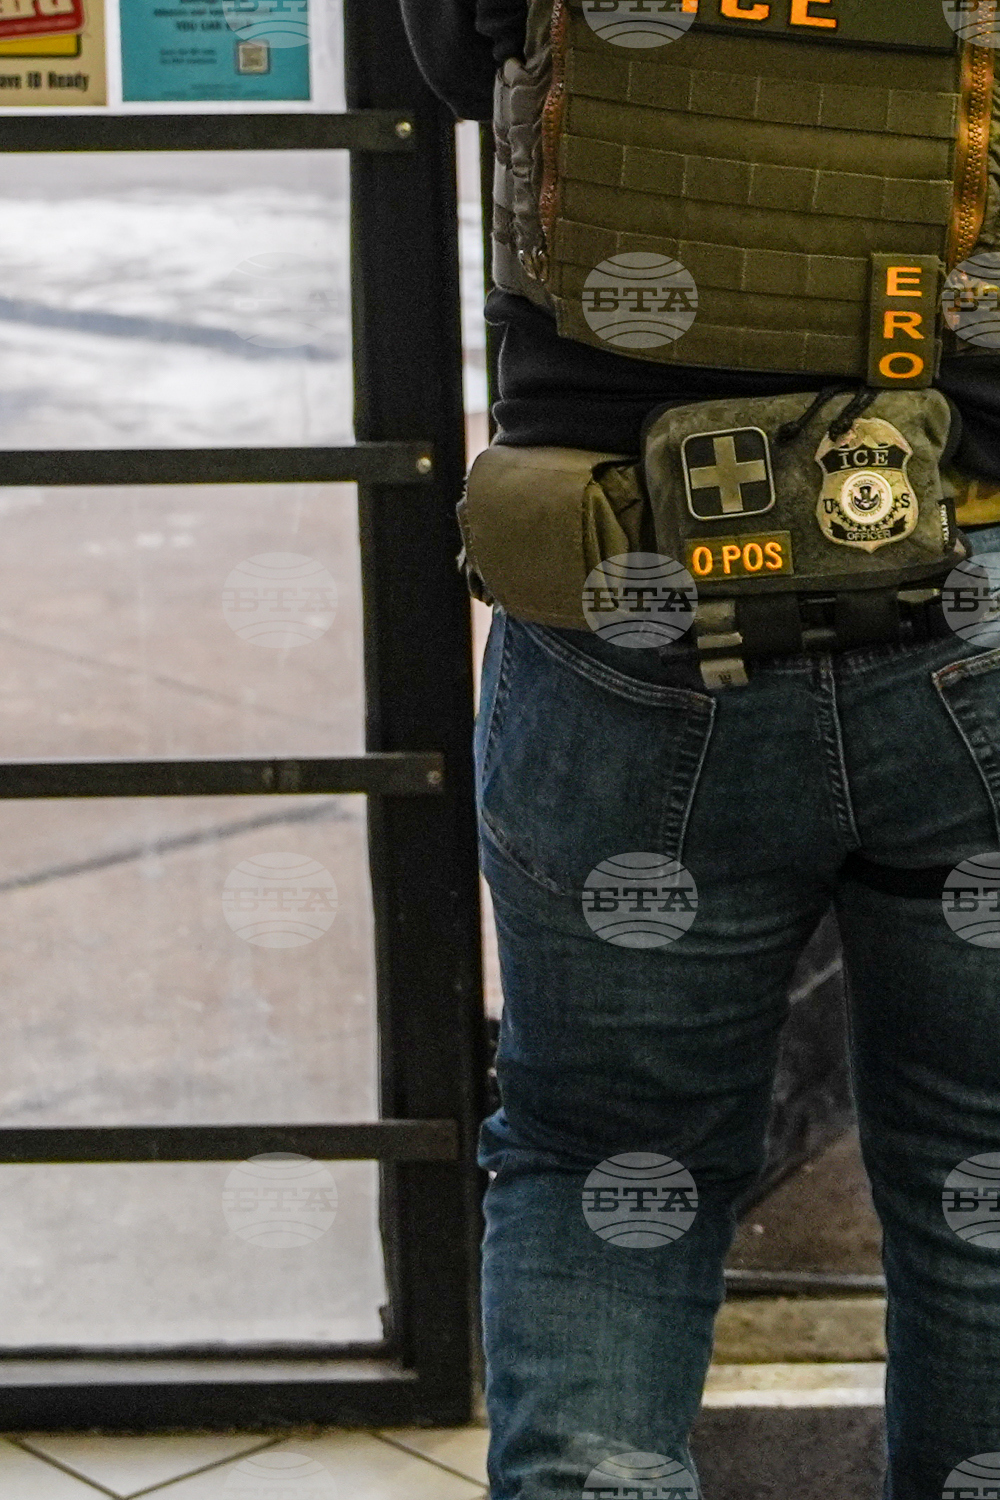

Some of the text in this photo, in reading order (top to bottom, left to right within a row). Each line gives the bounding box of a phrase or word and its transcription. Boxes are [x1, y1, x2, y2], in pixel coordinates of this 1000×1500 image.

[877, 265, 923, 380] ERO
[838, 449, 890, 469] ICE
[846, 529, 892, 542] OFFICER
[721, 541, 784, 574] POS
